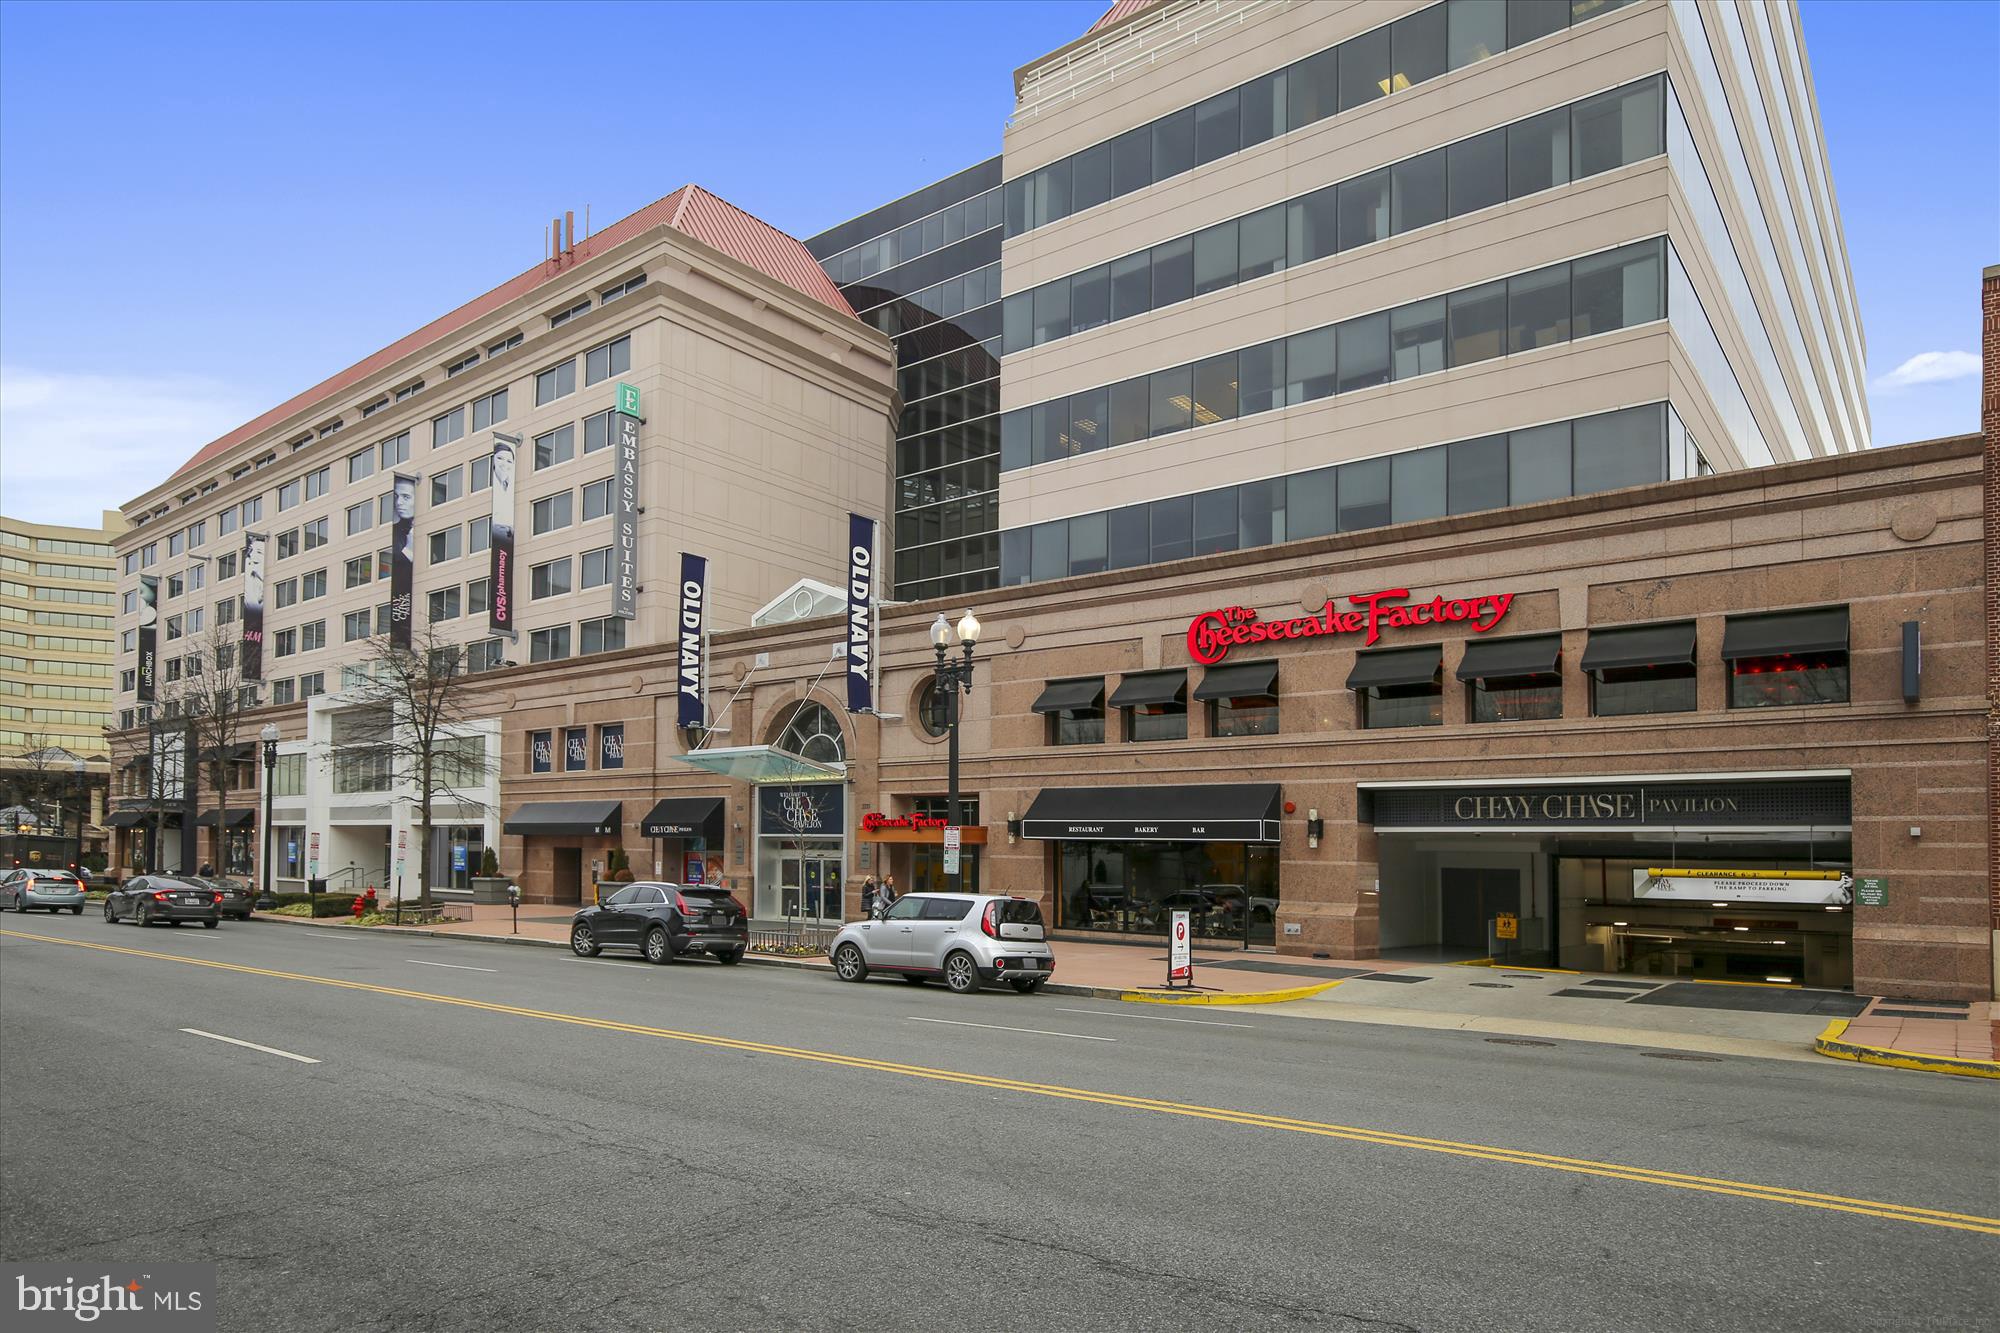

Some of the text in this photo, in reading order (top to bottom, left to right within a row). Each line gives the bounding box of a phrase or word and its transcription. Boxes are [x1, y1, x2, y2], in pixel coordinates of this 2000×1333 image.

[621, 420, 637, 602] EMBASSY SUITES
[496, 550, 507, 622] CVS/pharmacy
[850, 545, 870, 681] OLD NAVY
[1225, 605, 1256, 623] The
[681, 581, 702, 700] OLD NAVY
[1187, 588, 1515, 664] Cheesecake Factory
[145, 651, 153, 687] LUNCHBOX
[1454, 794, 1738, 820] CHEVY CHASE PAVILION
